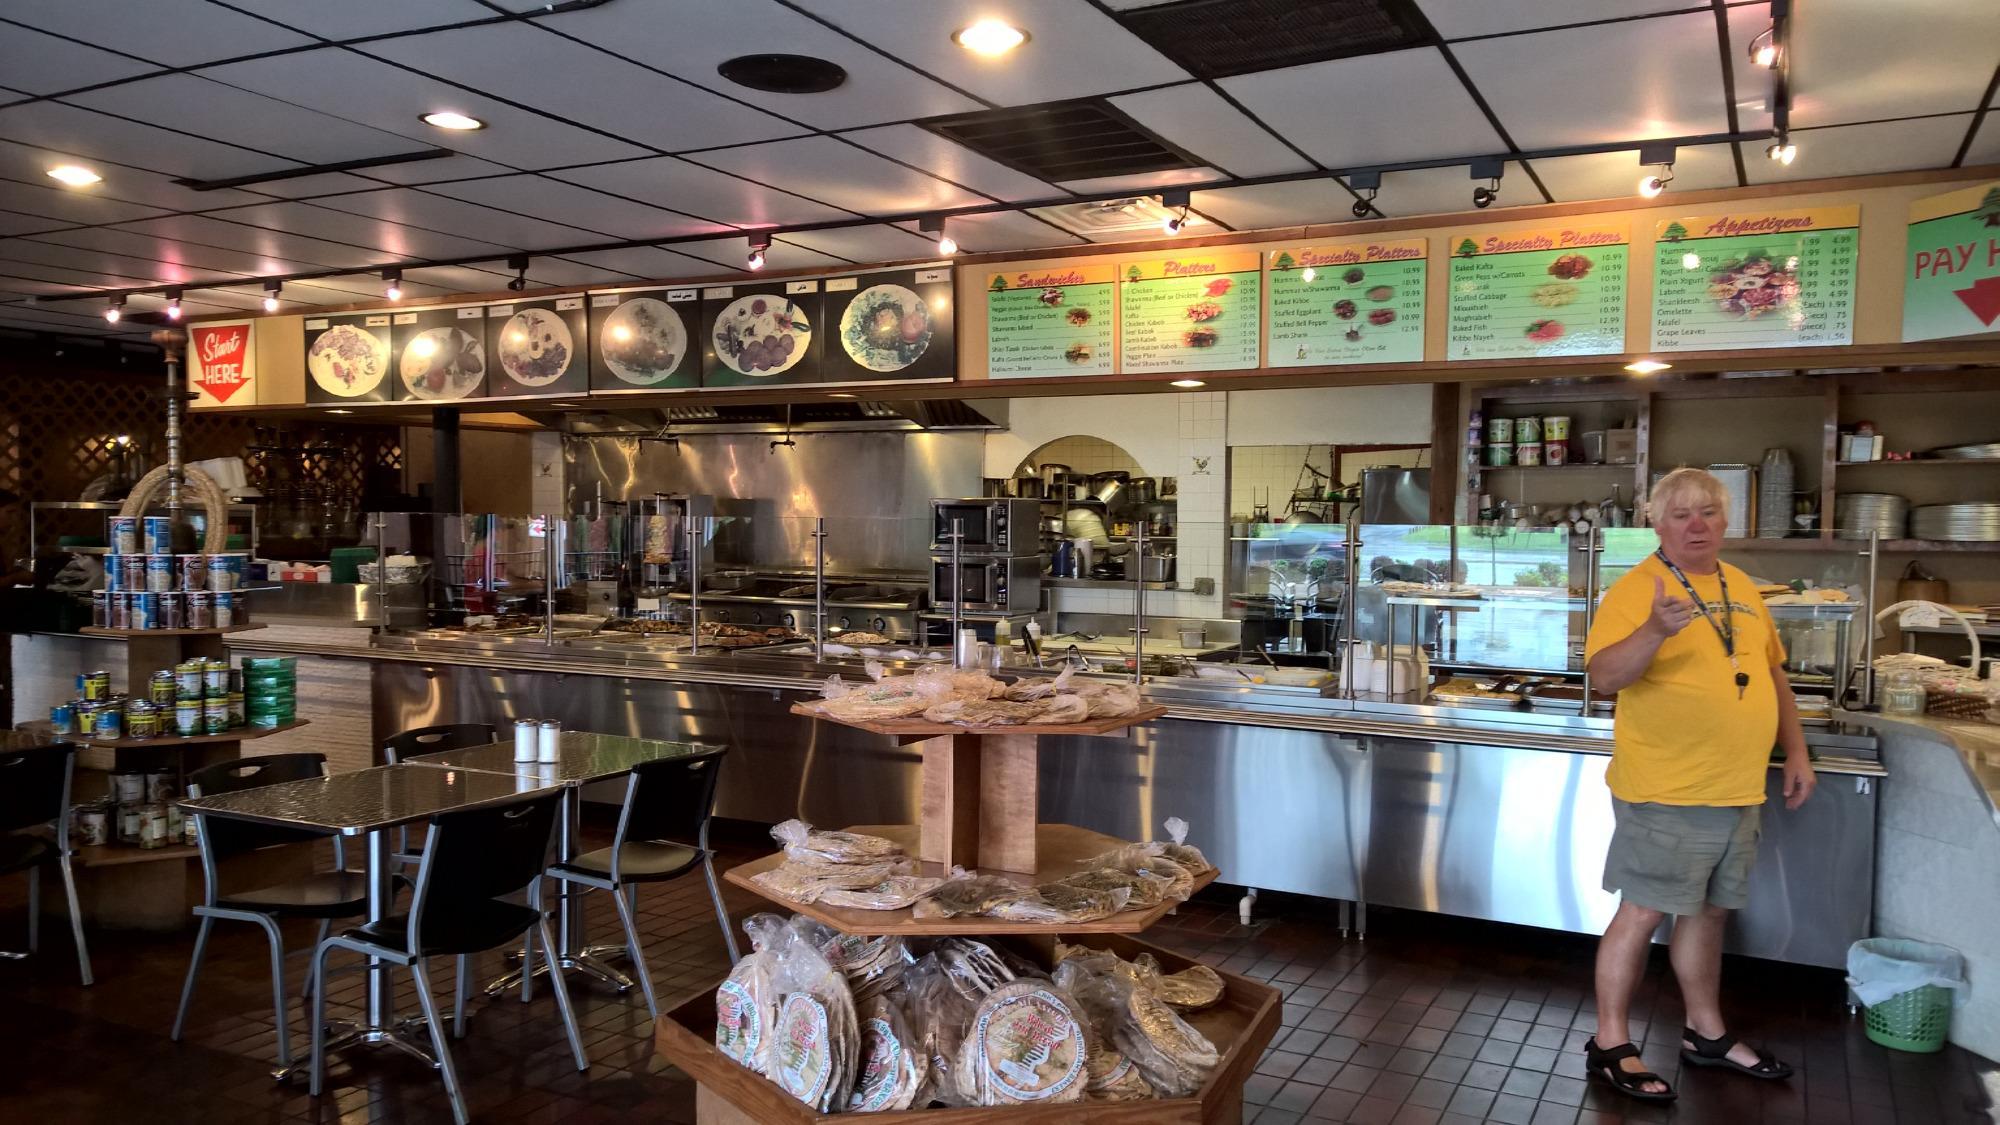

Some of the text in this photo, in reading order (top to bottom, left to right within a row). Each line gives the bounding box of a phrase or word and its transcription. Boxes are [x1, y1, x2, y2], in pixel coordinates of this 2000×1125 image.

[1704, 215, 1813, 236] Appetizers
[1484, 230, 1622, 253] Specialty Platters
[1832, 235, 1851, 244] 4.99
[1299, 245, 1420, 265] Specialty Platters
[1832, 247, 1850, 255] 4.99
[1832, 258, 1850, 266] 4.99
[1915, 242, 1976, 279] PAY
[1164, 261, 1216, 276] Platters
[1017, 272, 1086, 287] Sandwiches
[1680, 276, 1704, 286] Yogurt
[1831, 268, 1849, 277] 4.99
[1830, 279, 1848, 288] 4.99
[1829, 290, 1848, 299] 4.99
[1657, 307, 1692, 316] Omelette
[1829, 300, 1846, 309] 1.99
[1657, 319, 1680, 327] Falafel
[1657, 328, 1680, 337] Grape
[203, 331, 240, 362] Start
[205, 363, 240, 385] HERE
